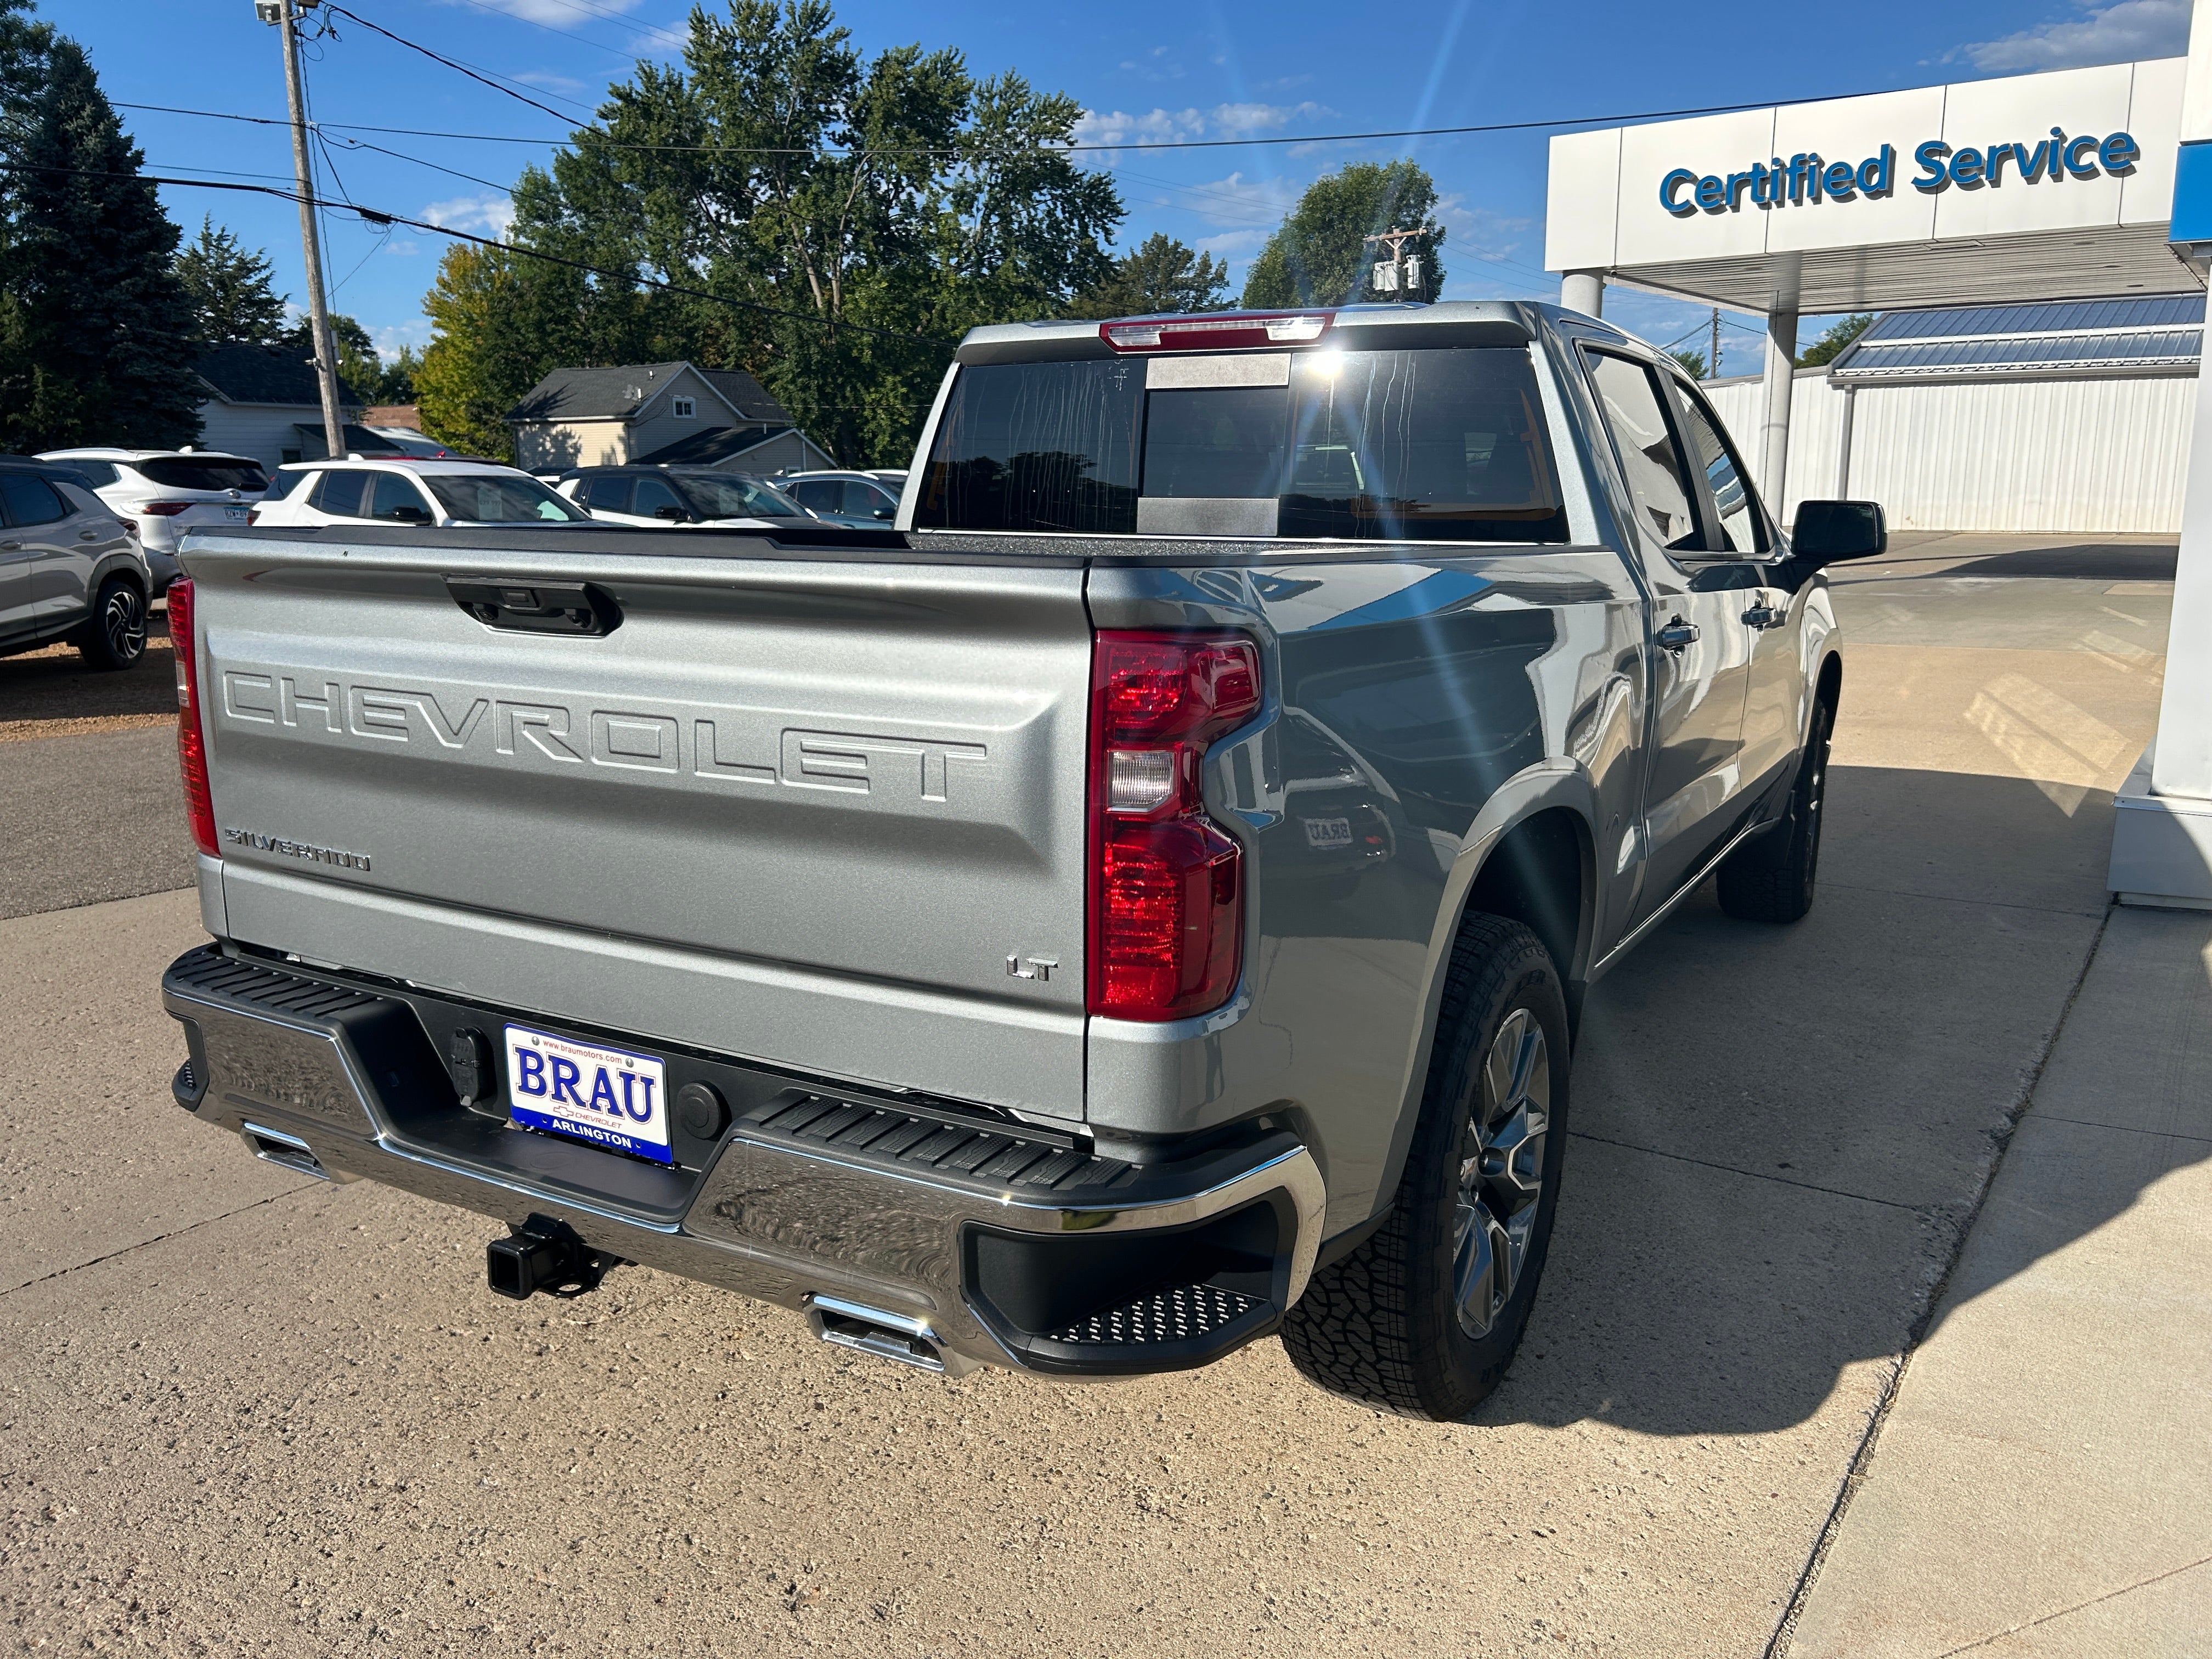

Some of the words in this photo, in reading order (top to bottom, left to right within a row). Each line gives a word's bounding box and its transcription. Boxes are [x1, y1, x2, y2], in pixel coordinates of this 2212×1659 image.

[1660, 143, 1894, 214] Certified
[1911, 127, 2136, 190] Service
[223, 670, 987, 802] CHEVROLET
[224, 828, 371, 871] SILVERADO
[1006, 955, 1058, 981] LT
[543, 1040, 622, 1064] www.braumotors.com
[513, 1044, 656, 1125] BRAU
[552, 1118, 632, 1149] ARLINGTON
[575, 1112, 623, 1129] CHEVROLET
